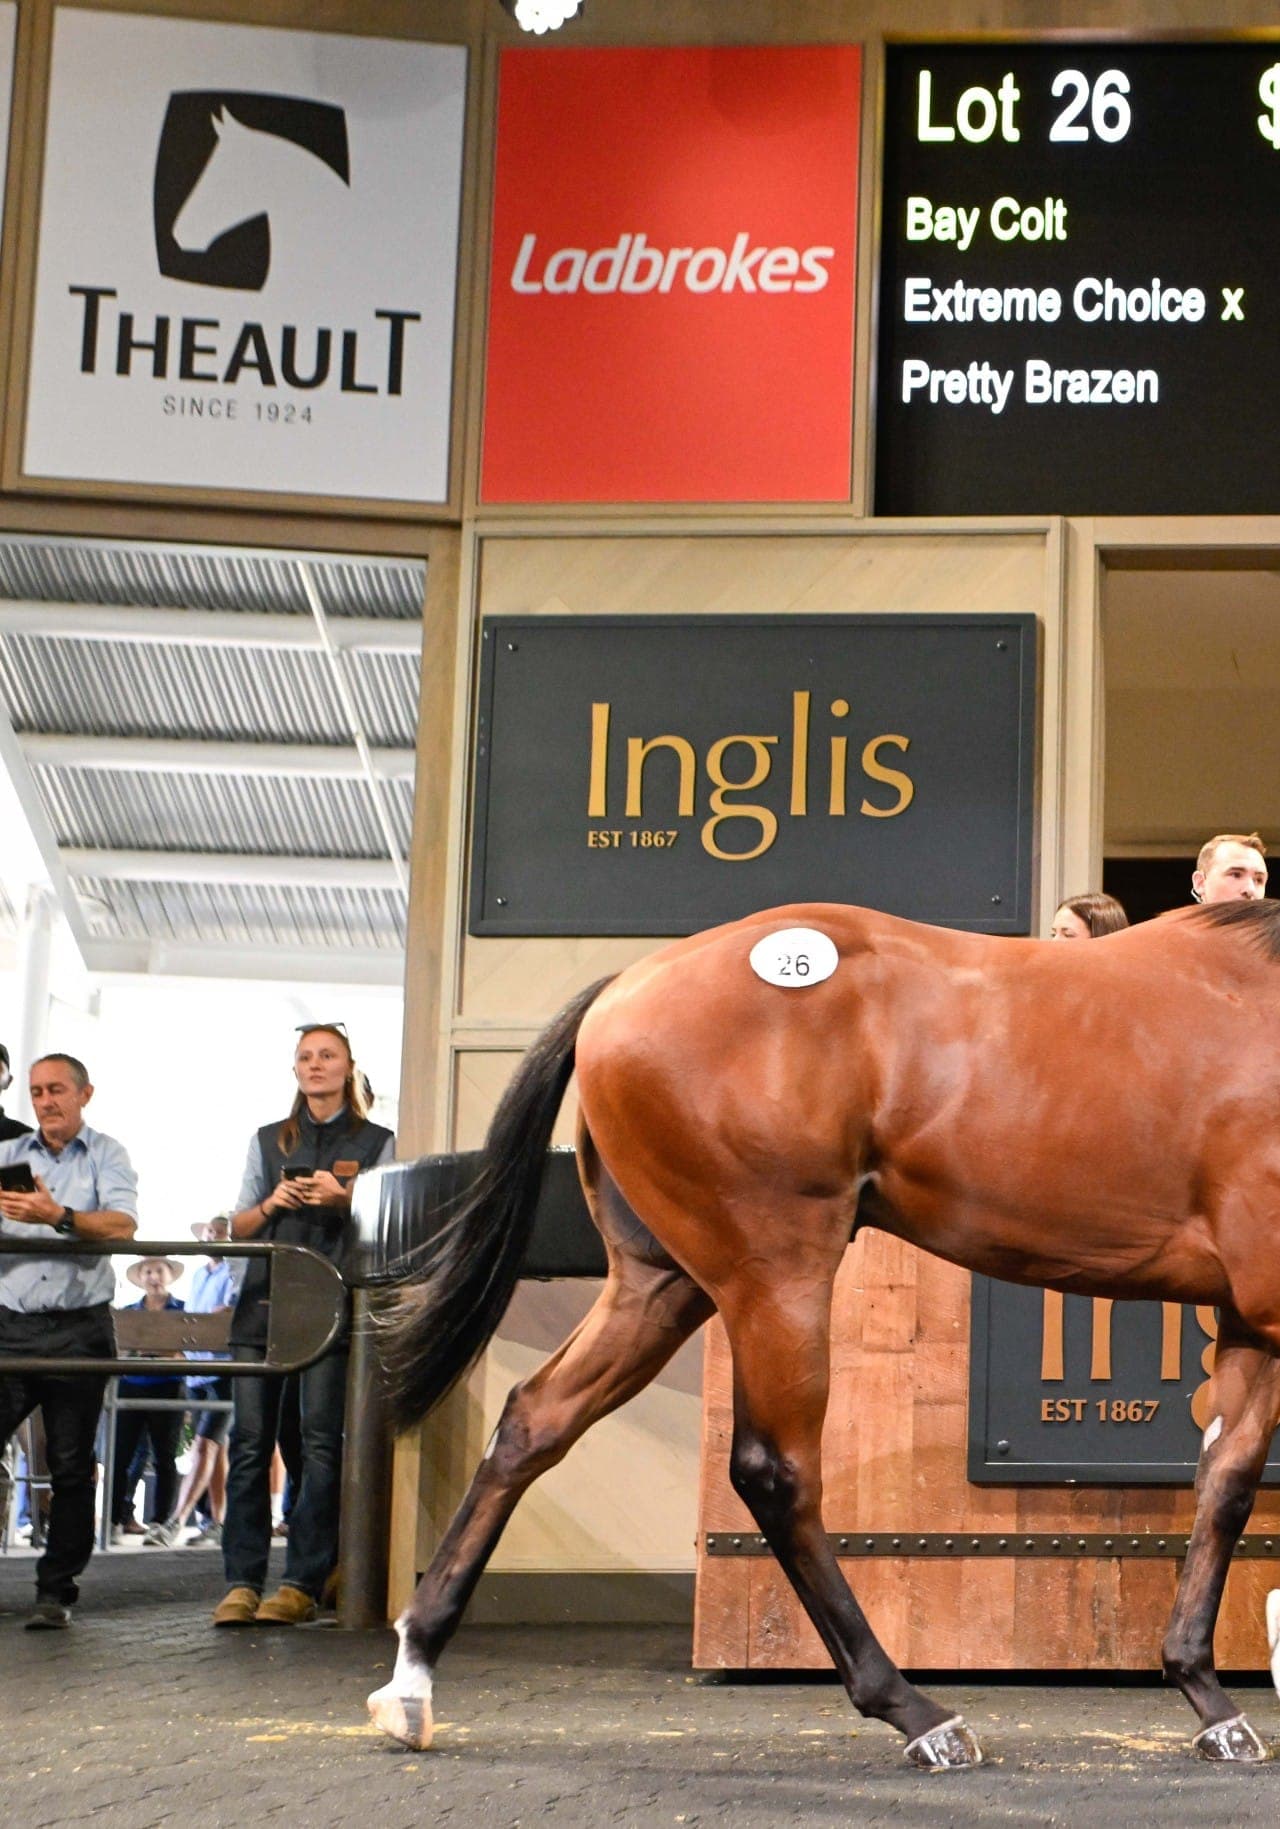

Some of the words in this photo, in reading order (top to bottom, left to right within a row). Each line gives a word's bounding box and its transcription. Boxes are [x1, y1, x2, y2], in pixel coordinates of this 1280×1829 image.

[917, 70, 1021, 143] Lot
[1049, 70, 1132, 143] 26
[905, 197, 980, 250] Bay
[990, 197, 1067, 242] Colt
[512, 233, 834, 294] Ladbrokes
[904, 278, 1061, 323] Extreme
[1073, 278, 1206, 323] Choice
[1221, 288, 1245, 321] x
[69, 284, 421, 396] THEAULT
[163, 394, 237, 419] SINCE
[255, 402, 312, 424] 1924
[902, 360, 1014, 414] Pretty
[1025, 360, 1159, 404] Brazen
[588, 691, 915, 860] Inglis
[587, 831, 621, 848] EST
[629, 830, 678, 847] 1867
[778, 954, 810, 976] 26
[1041, 1400, 1084, 1422] EST
[1096, 1400, 1159, 1422] 1867
